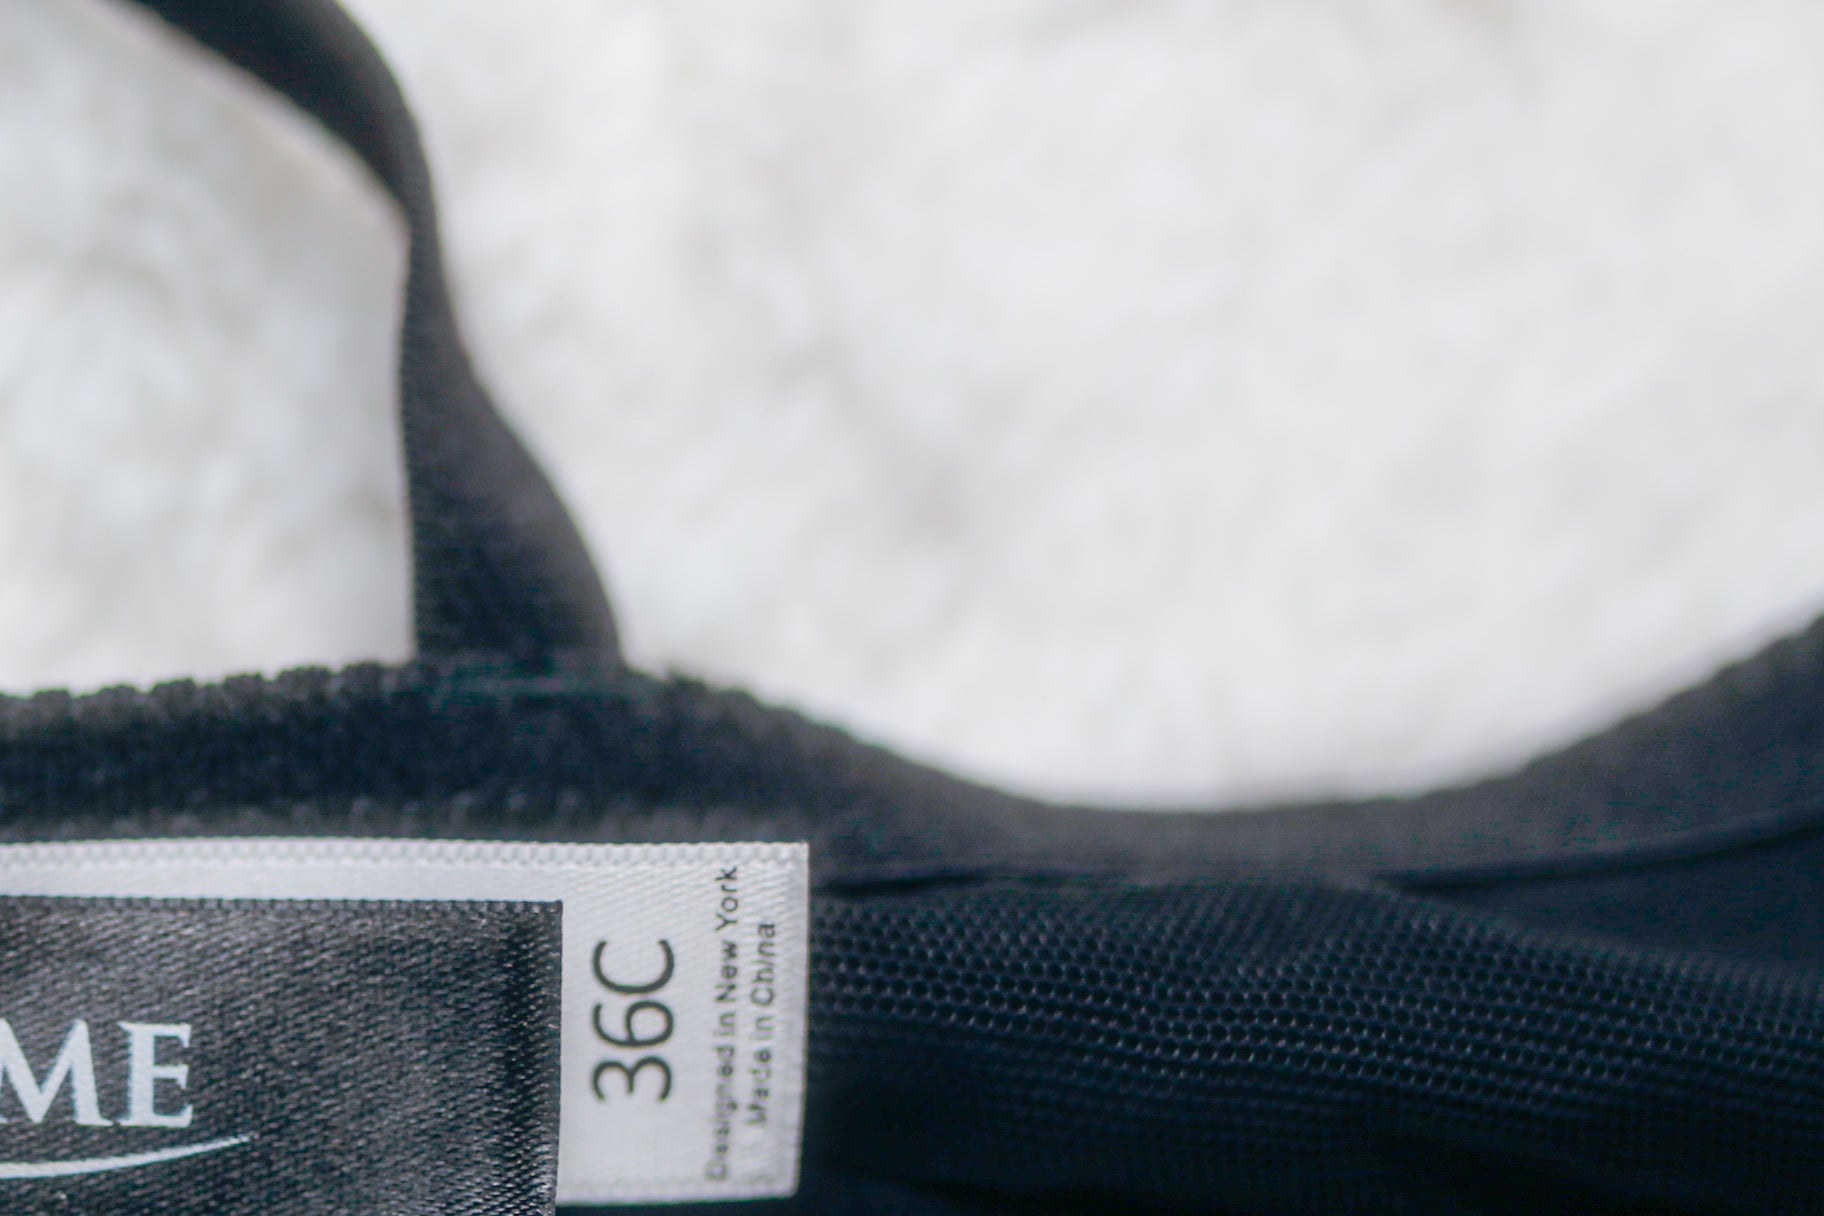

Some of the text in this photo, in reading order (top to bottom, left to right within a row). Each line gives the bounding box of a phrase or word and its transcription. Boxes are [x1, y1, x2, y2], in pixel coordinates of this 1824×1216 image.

[591, 939, 675, 1103] 36C
[705, 866, 739, 1182] Designed in New York
[747, 922, 777, 1125] Made in China
